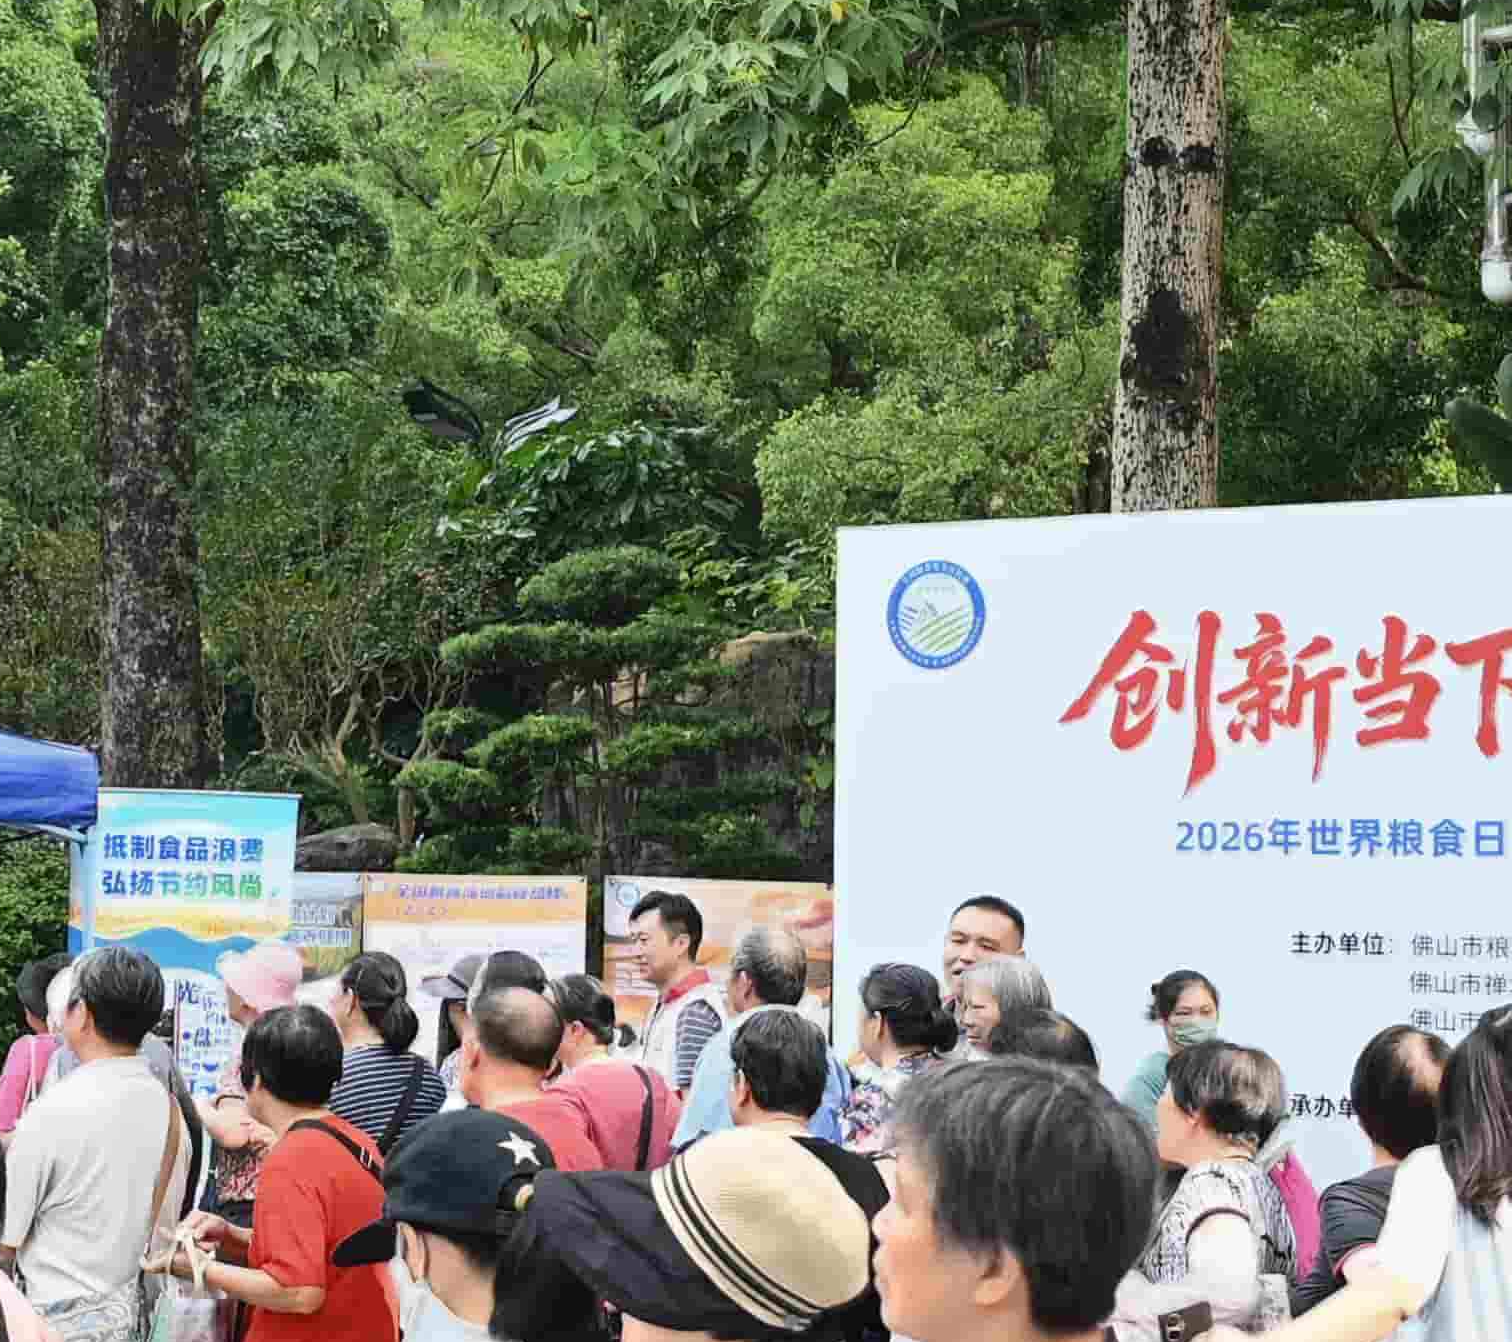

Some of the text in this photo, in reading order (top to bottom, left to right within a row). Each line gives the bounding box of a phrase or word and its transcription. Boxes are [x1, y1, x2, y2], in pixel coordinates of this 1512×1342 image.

[103, 832, 265, 864] 抵制食品浪费
[102, 868, 264, 901] 弘扬节约风尚
[1288, 1091, 1356, 1119] 承办单
